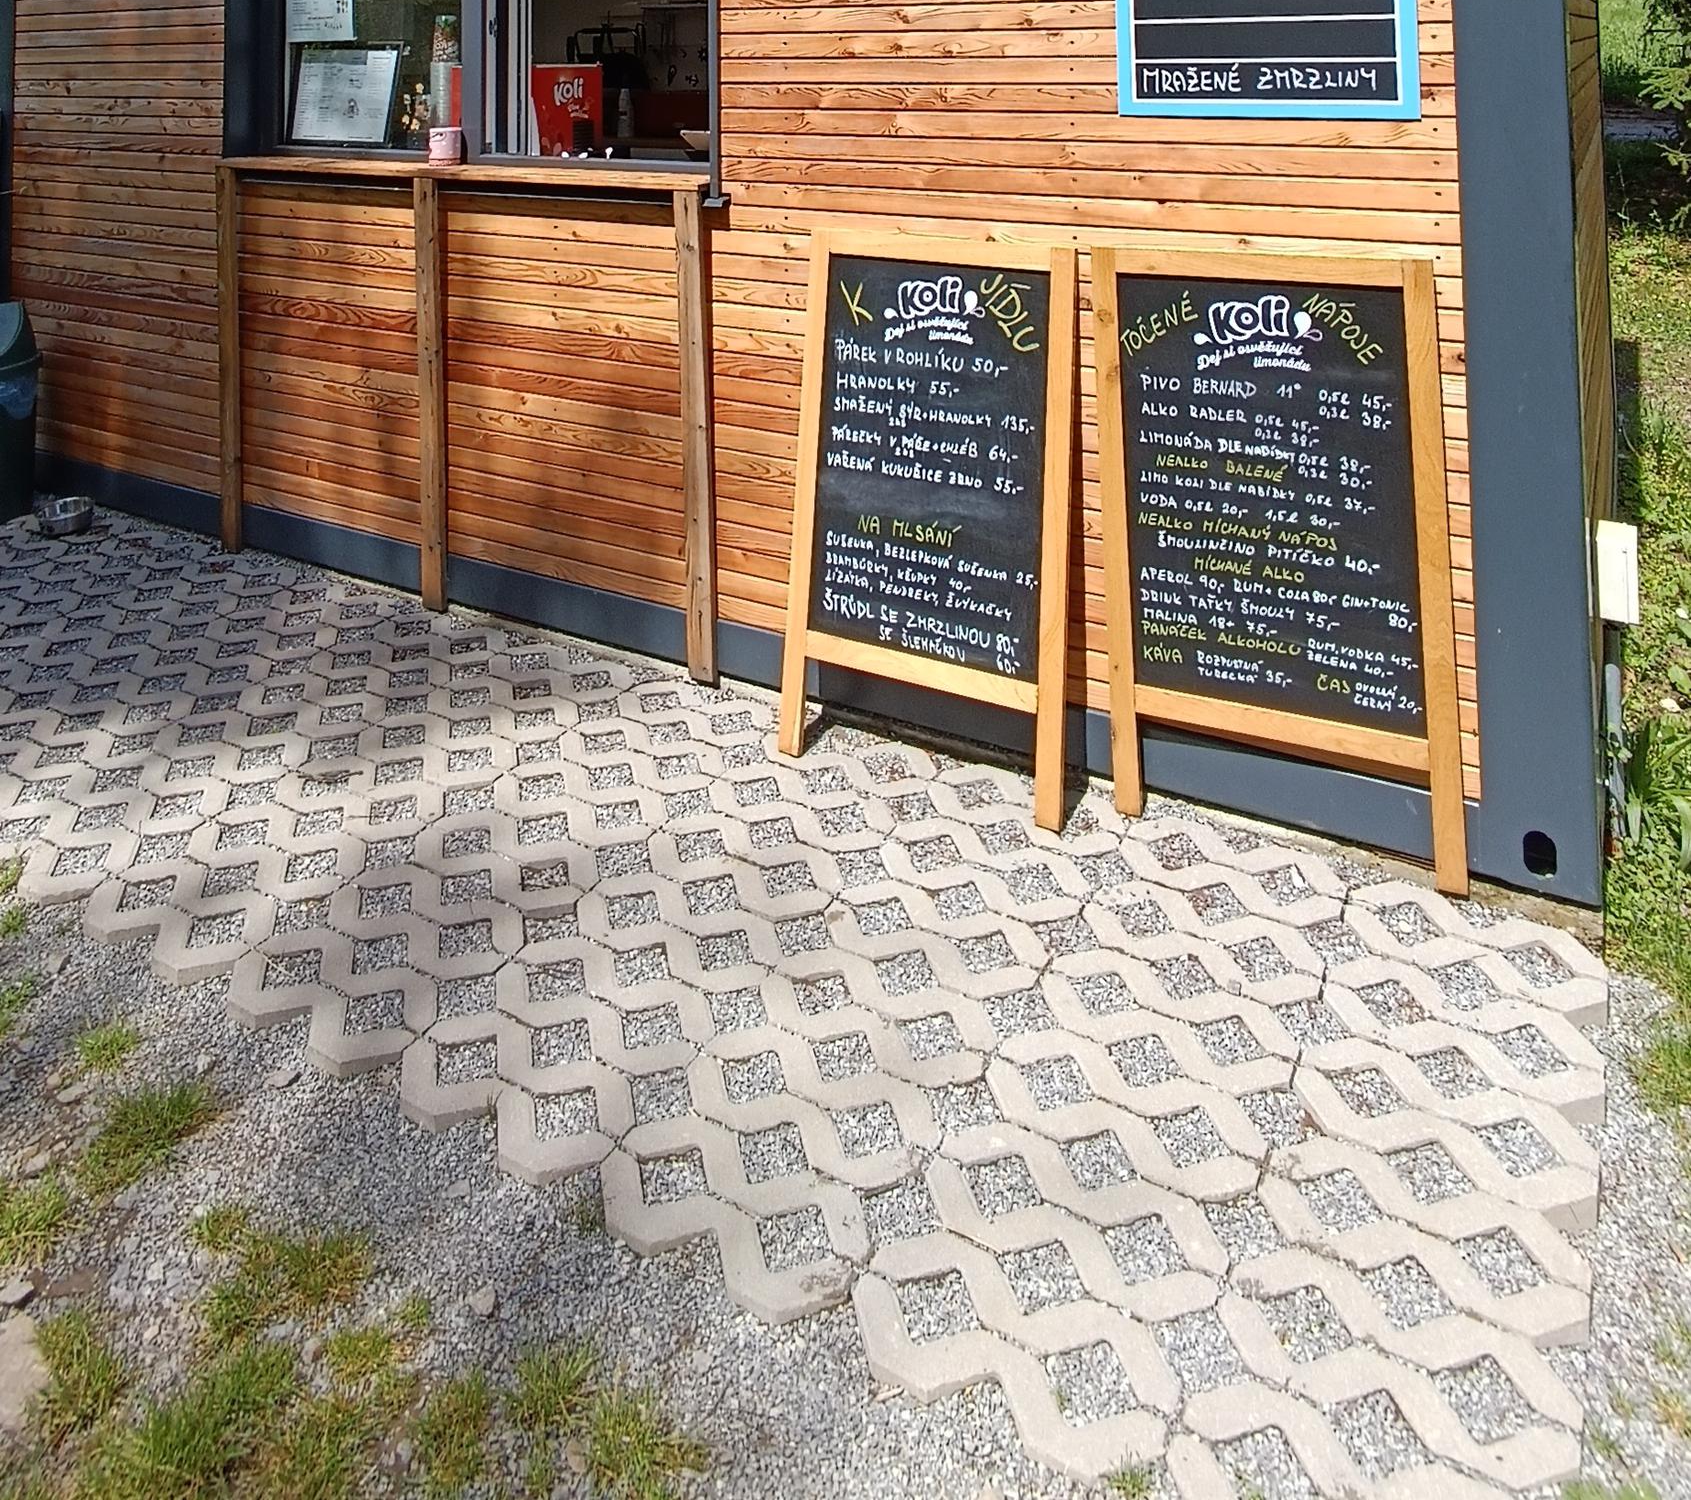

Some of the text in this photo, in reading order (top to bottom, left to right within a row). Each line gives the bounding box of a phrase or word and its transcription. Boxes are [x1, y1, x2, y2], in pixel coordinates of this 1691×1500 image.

[1143, 63, 1377, 93] MRAŽENÉ ZMRZLINY
[840, 273, 1040, 352] K JÍDLU
[1301, 293, 1384, 365] NÁPOJE
[835, 337, 1009, 378] PÁREK V ROHLÍKU 50,-
[1197, 349, 1222, 371] Dej
[1222, 345, 1236, 358] si
[1253, 355, 1312, 373] limonádu
[836, 371, 960, 398] HRANOLKY 55,-
[1139, 373, 1181, 392] PIVO
[1192, 376, 1257, 399] BERNARD
[834, 395, 893, 416] SMAŽENÝ
[1000, 414, 1036, 435] 135,-
[1141, 402, 1178, 417] ALKO
[1189, 404, 1247, 424] RADLER
[889, 434, 898, 449] V
[1139, 429, 1213, 452] LIMONÁDA
[1217, 437, 1242, 454] DLE
[1155, 453, 1288, 483] NEALKO BALENÉ
[1140, 470, 1169, 485] LIMO
[1209, 478, 1233, 493] DLE
[1238, 480, 1296, 501] NABÍDKY
[1140, 491, 1178, 509] VODA
[857, 514, 881, 536] NA
[1138, 511, 1193, 531] NEALKO
[1202, 516, 1271, 541] MÍCHANÝ
[1267, 543, 1335, 567] PITÍČKO
[1193, 554, 1305, 583] MÍCHANÉ ALKO
[1140, 566, 1193, 586] APEROL
[1277, 586, 1310, 601] COLA
[1140, 588, 1182, 606] DRINK
[1240, 598, 1294, 621] ŠMOULY
[1143, 607, 1198, 626] MALINA
[879, 624, 893, 641] SE
[880, 604, 899, 623] SE
[905, 610, 992, 649] ZMRZLINOU
[1142, 641, 1183, 664] KÁVA
[1217, 631, 1301, 656] ALKOHOLU
[1340, 645, 1385, 663] VODKA
